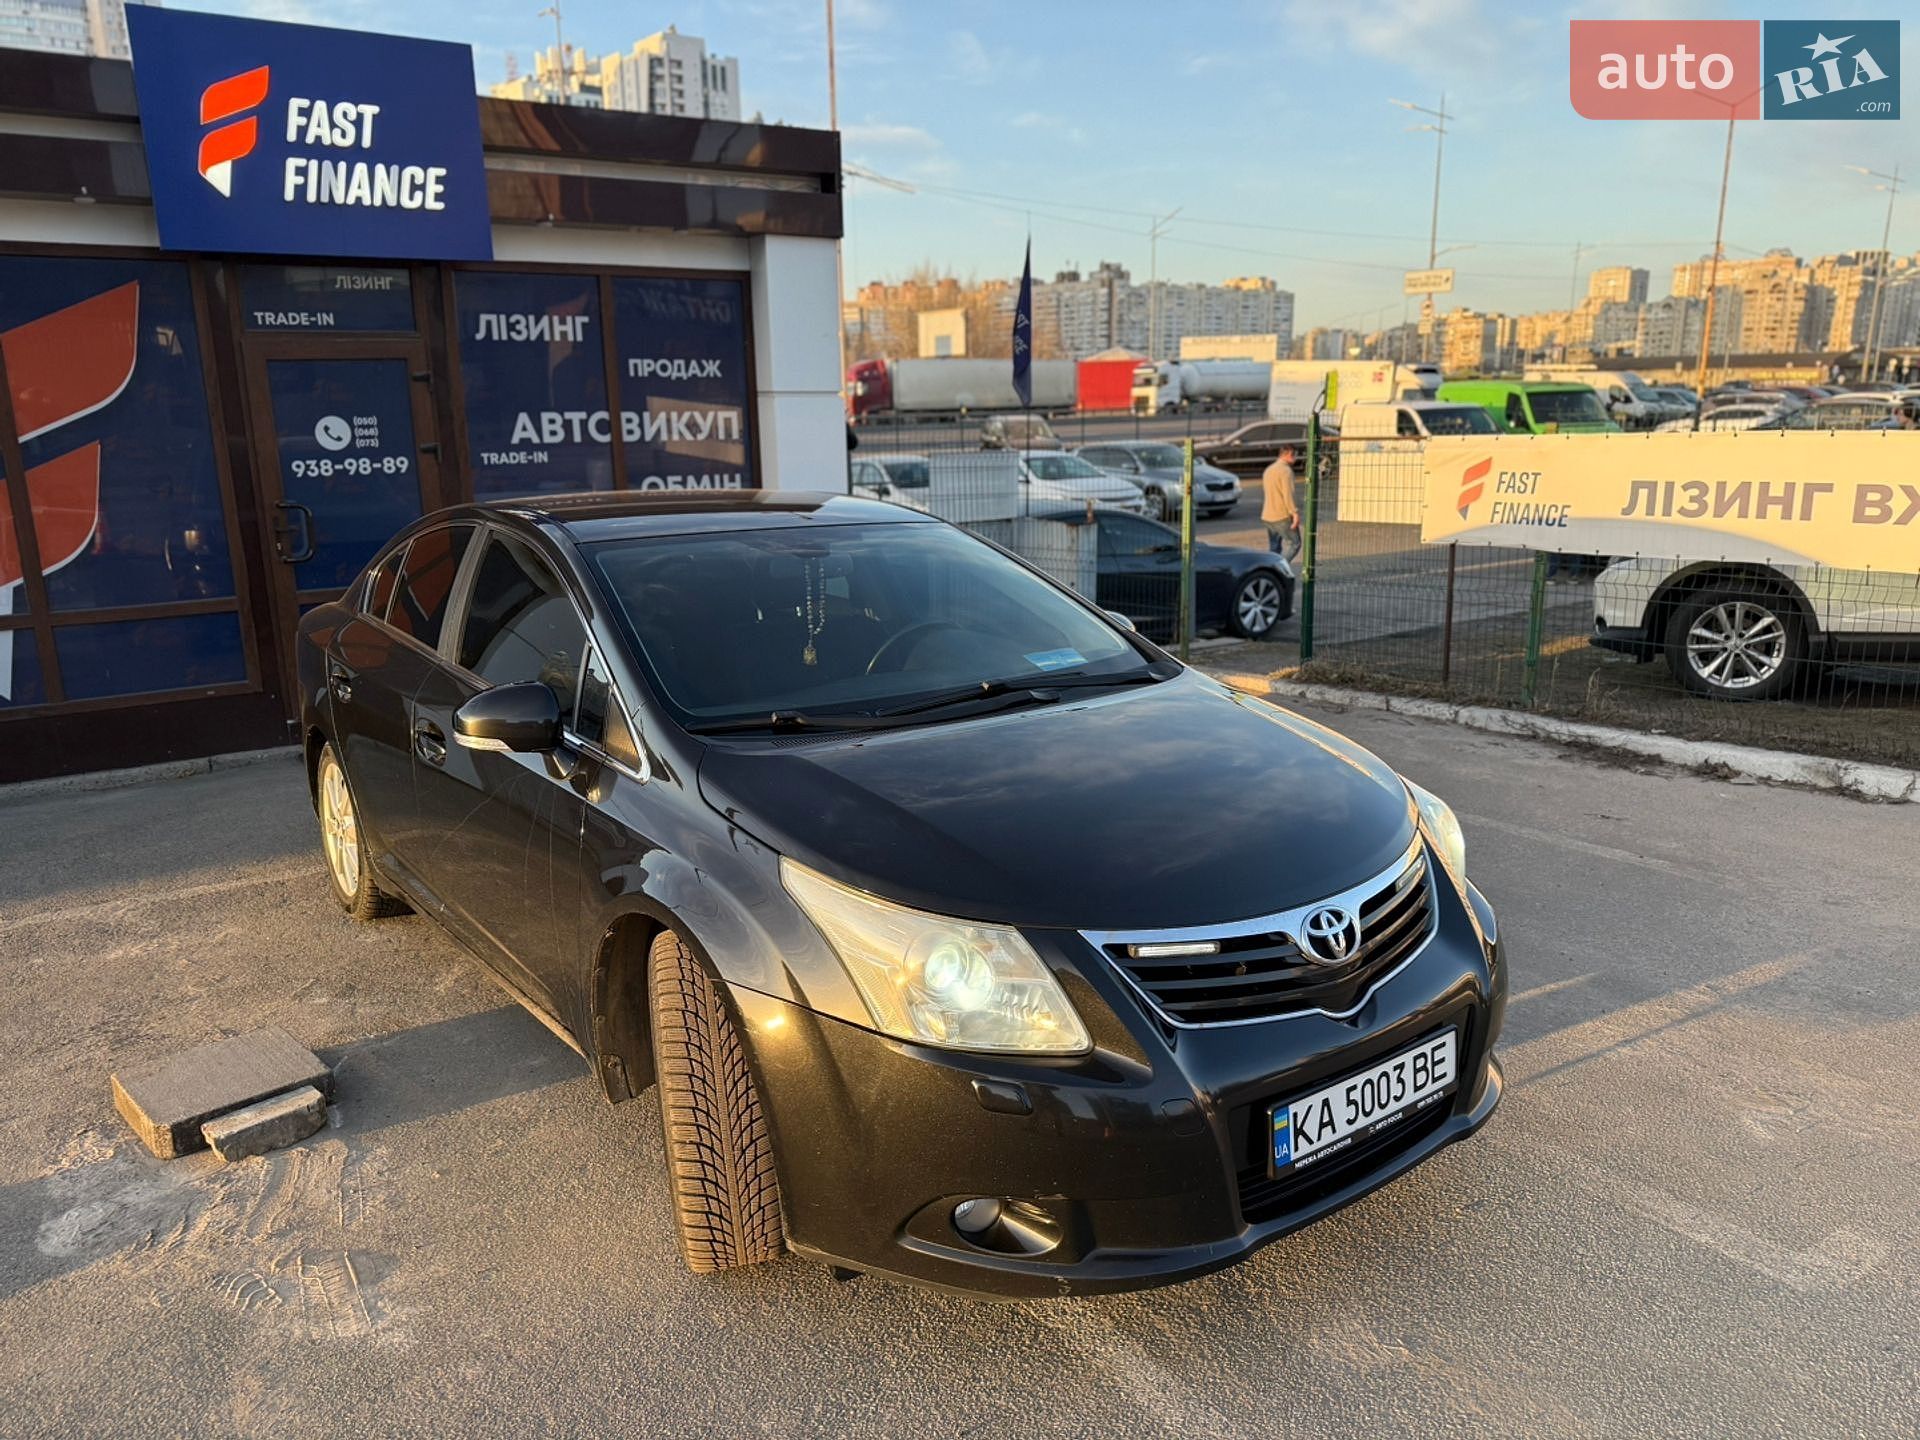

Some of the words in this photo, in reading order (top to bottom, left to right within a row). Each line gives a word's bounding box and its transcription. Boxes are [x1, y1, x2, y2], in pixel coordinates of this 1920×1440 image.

[286, 97, 380, 149] FAST
[283, 156, 447, 211] FINANCE
[334, 275, 393, 291] ЛІЗИНГ
[253, 311, 335, 326] TRADE-IN
[475, 313, 589, 342] ЛІЗИНГ
[628, 358, 722, 380] ПРОДАЖ
[291, 456, 409, 477] 938-98-89
[480, 451, 548, 465] TRADE-IN
[1496, 471, 1542, 495] FAST
[1621, 479, 1833, 522] ЛІЗИНГ
[1490, 501, 1571, 528] FINANCE
[1293, 1097, 1337, 1154] KA
[1345, 1061, 1406, 1126] 5003
[1413, 1041, 1448, 1094] BE
[1274, 1142, 1289, 1160] UA
